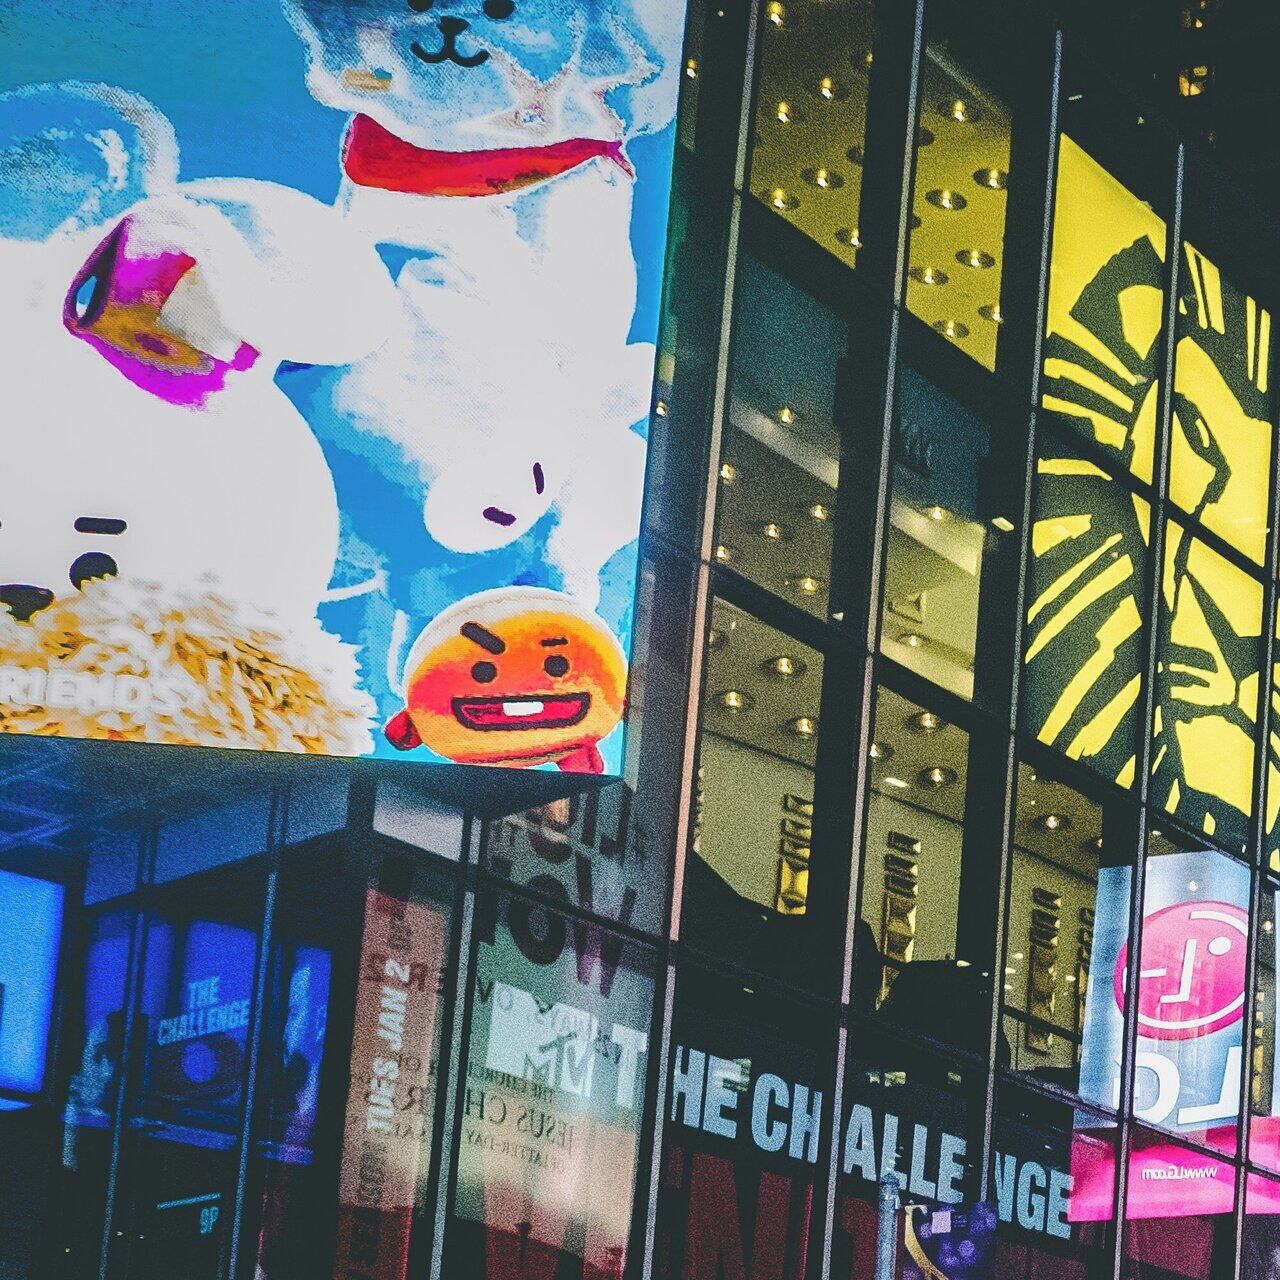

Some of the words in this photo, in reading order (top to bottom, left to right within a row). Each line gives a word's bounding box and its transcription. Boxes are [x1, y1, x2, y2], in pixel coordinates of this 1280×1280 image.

[188, 976, 220, 1009] THE
[386, 958, 411, 983] 2
[157, 999, 250, 1046] CHALLENGE
[378, 986, 409, 1053] JAN
[751, 1073, 1073, 1241] CHALLENGE
